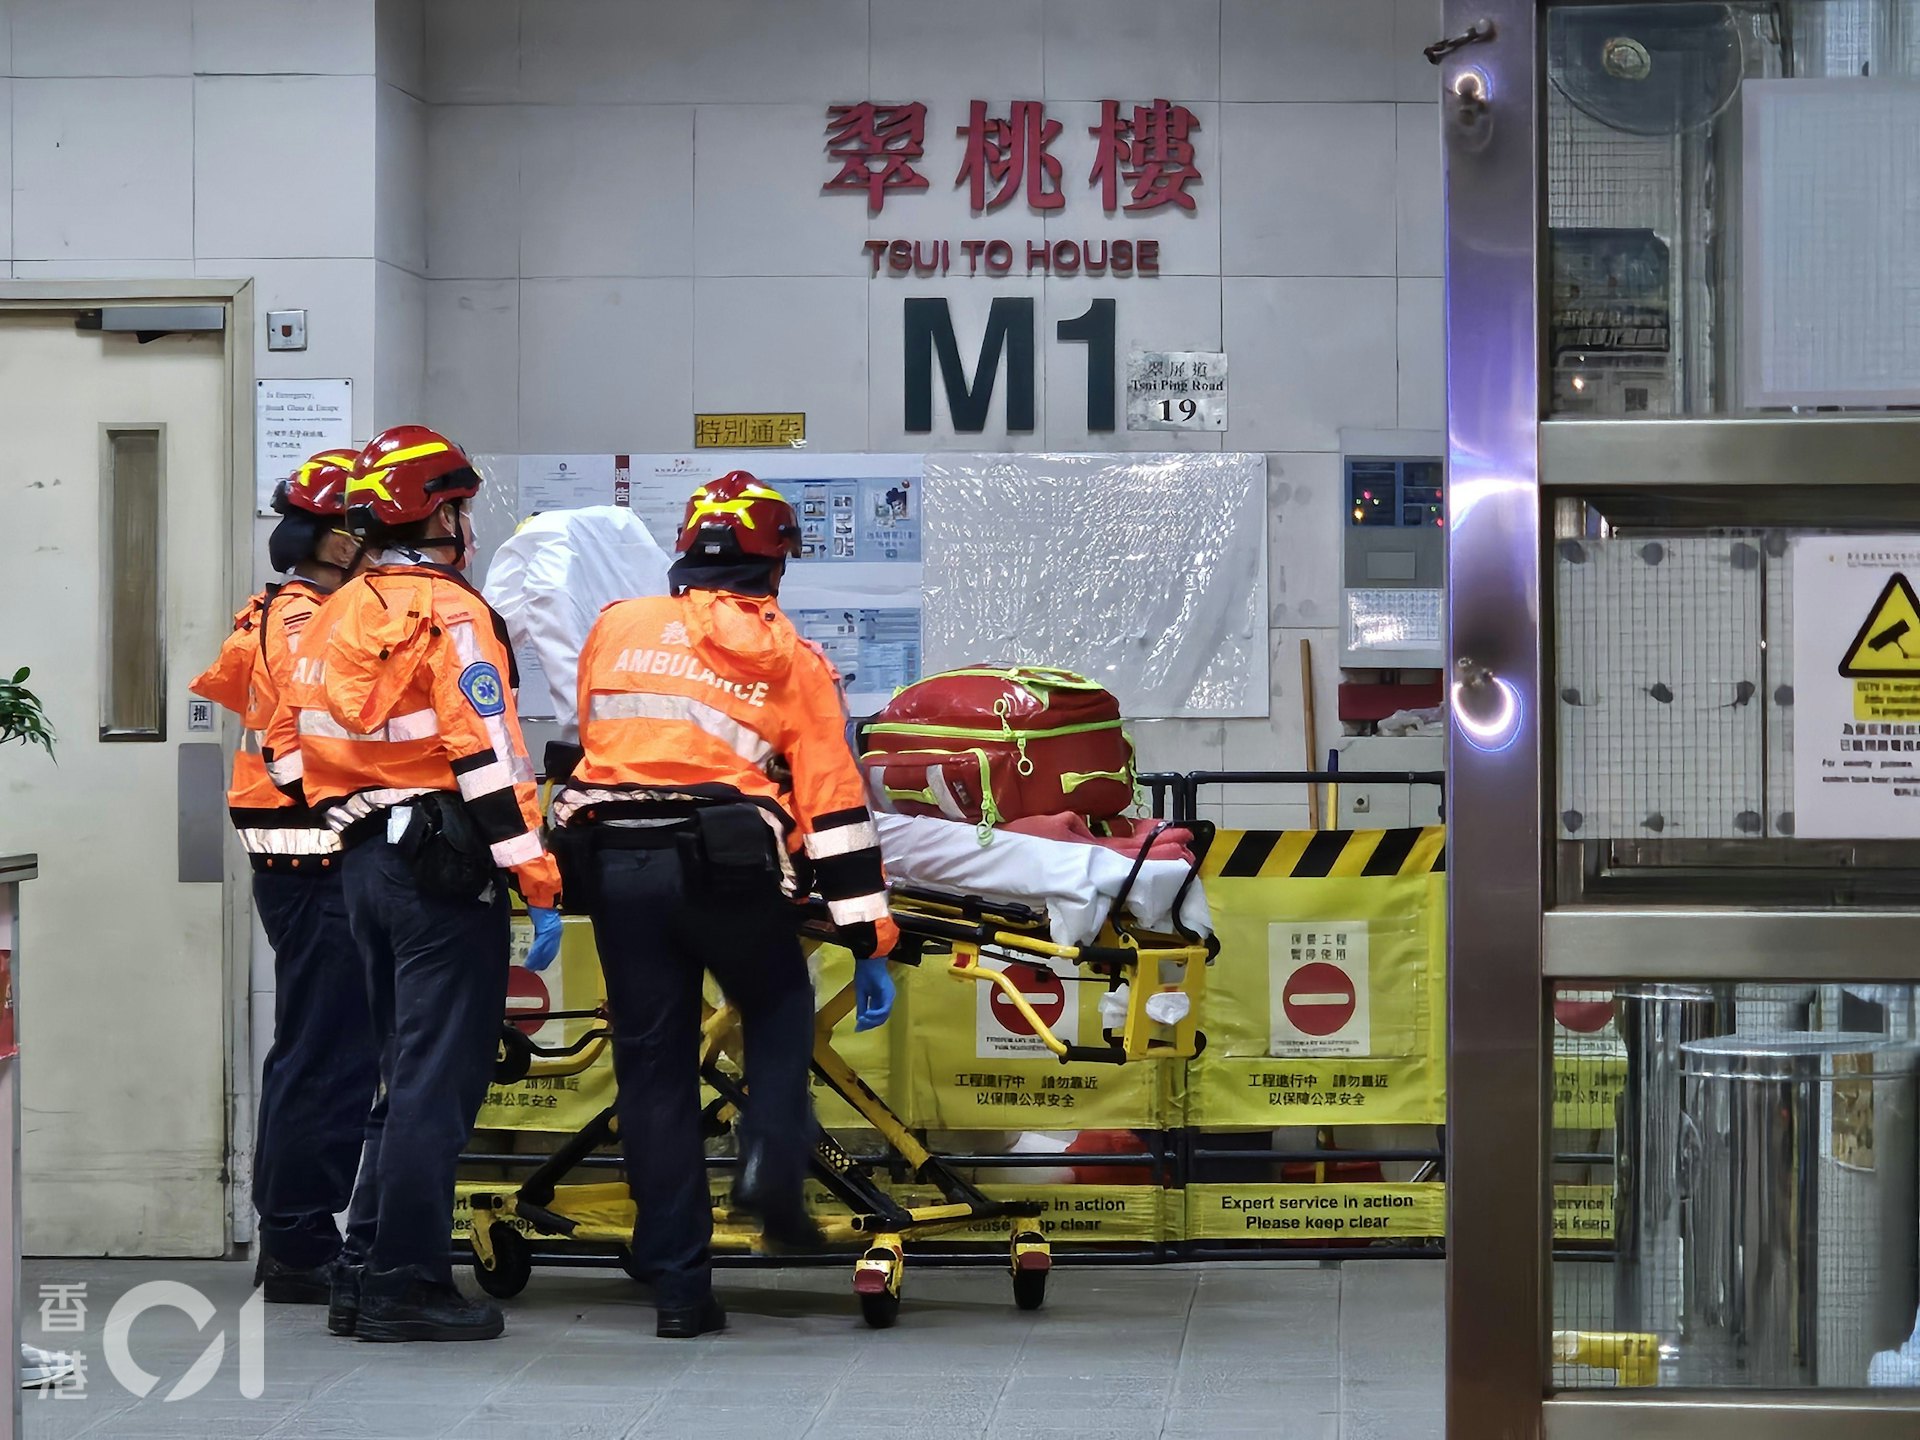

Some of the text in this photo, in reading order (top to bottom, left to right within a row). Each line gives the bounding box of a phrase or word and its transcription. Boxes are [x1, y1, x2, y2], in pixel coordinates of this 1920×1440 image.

[819, 98, 1203, 212] 翠桃樓
[865, 240, 1160, 271] TSUI TO HOUSE
[904, 297, 1116, 432] M1
[1161, 380, 1188, 392] Ping
[1192, 380, 1224, 391] Road
[1158, 398, 1197, 422] 19
[696, 418, 802, 444] 特別通告
[1248, 1073, 1317, 1088] 工程進行中
[1074, 1197, 1126, 1212] action
[1221, 1196, 1274, 1213] Expert
[1279, 1197, 1338, 1210] service
[1363, 1194, 1414, 1209] action
[1060, 1218, 1102, 1232] clear
[1246, 1215, 1390, 1232] Please keep clear
